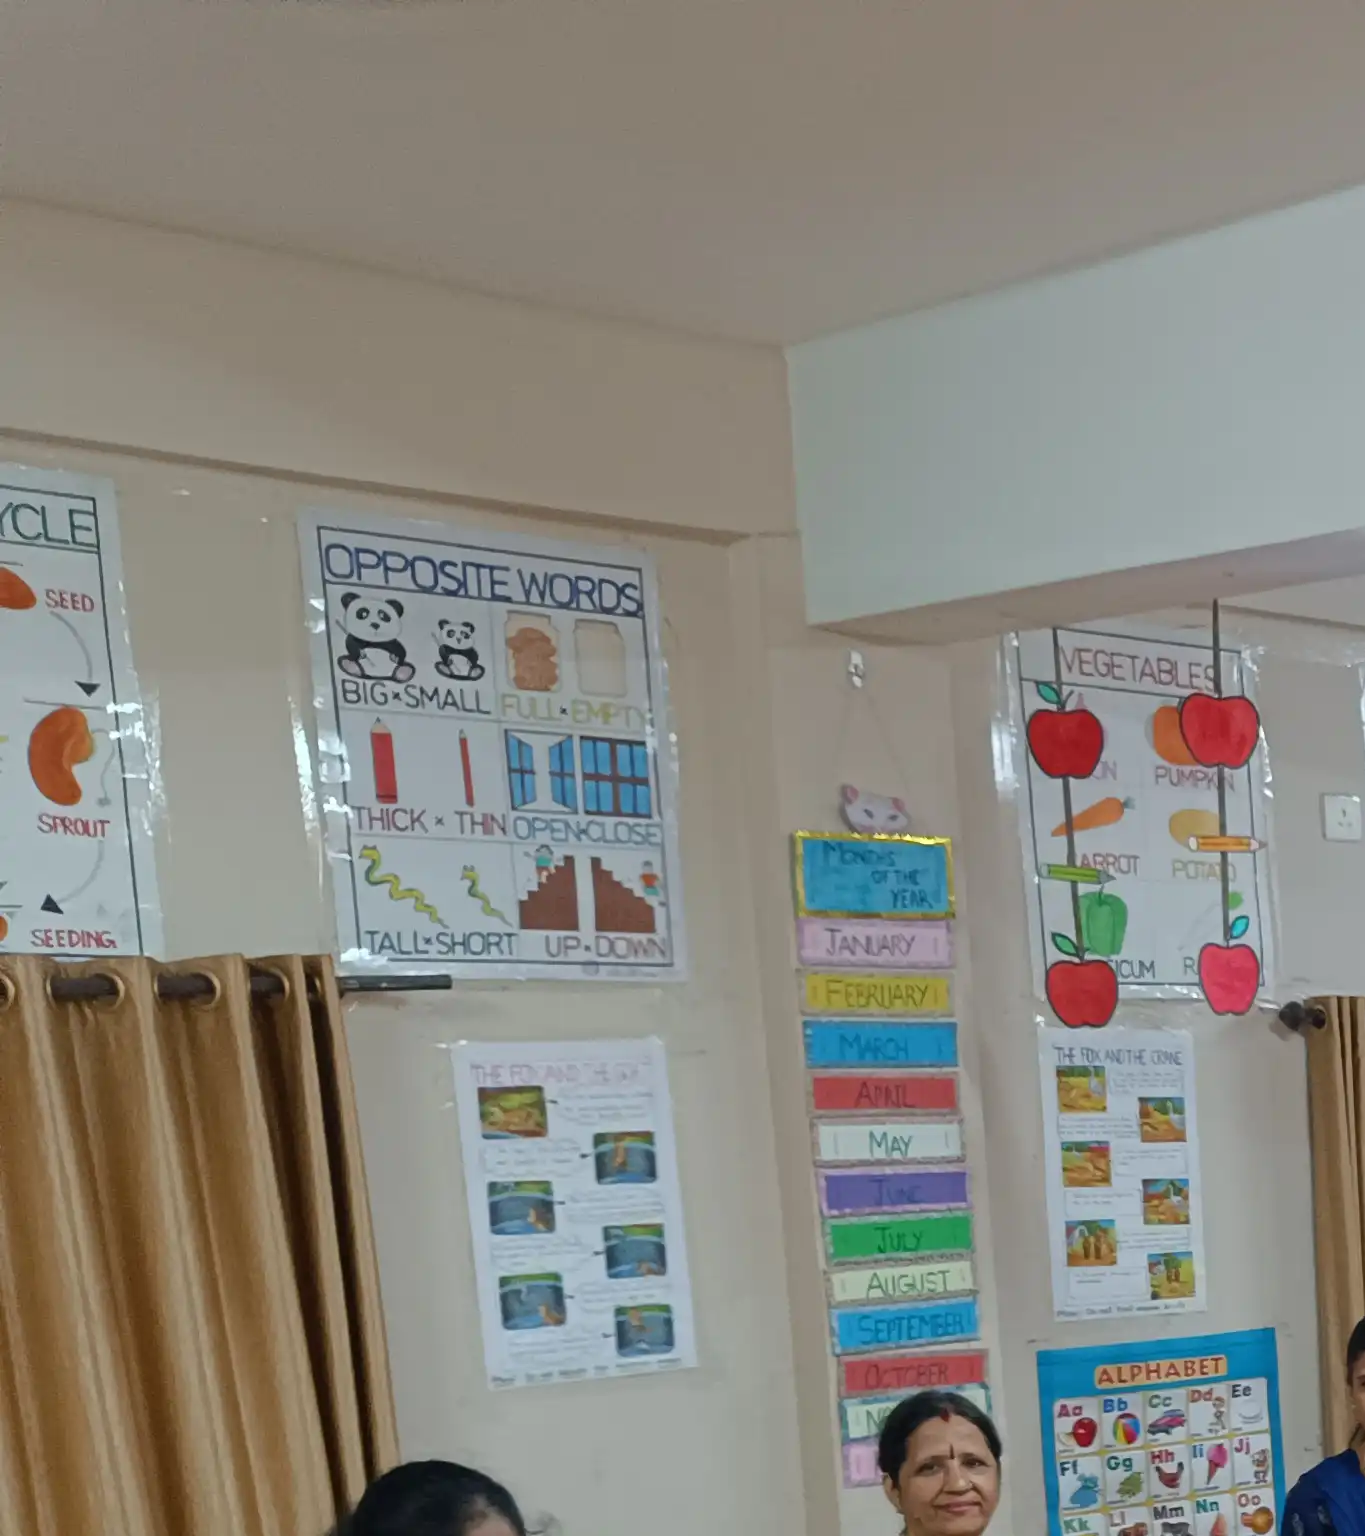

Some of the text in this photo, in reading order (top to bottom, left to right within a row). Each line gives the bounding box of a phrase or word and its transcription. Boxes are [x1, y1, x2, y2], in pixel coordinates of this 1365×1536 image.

[325, 543, 644, 616] OPPOSITE WORDS
[45, 588, 95, 613] SEED
[1060, 646, 1217, 692] VEGETABLES
[341, 678, 492, 715] BIG SMALL
[501, 694, 655, 727] FULL EMPTY
[1155, 765, 1235, 792] PUMPKN
[37, 813, 110, 838] SPROUT
[352, 806, 507, 836] THICK THIN
[512, 817, 661, 846] OPEN CLOSE
[821, 839, 896, 867] MONTHS
[1075, 853, 1140, 875] ARROT
[891, 868, 920, 886] THE
[889, 888, 933, 909] YEAR
[30, 928, 117, 950] SEEDING
[364, 930, 517, 957] TALL SHORT
[545, 934, 665, 960] UP DOWN
[824, 927, 917, 958] JANUARY
[825, 978, 930, 1010] FEBRUARY
[838, 1033, 909, 1061] MARCH
[1080, 1046, 1101, 1064] FOX
[854, 1080, 917, 1109] APRIL
[868, 1130, 914, 1157] MAY
[874, 1226, 924, 1253] JULY
[866, 1270, 952, 1299] AUGUST
[858, 1313, 965, 1345] SEPTEMBER
[864, 1362, 950, 1388] OCTOBER
[1098, 1356, 1225, 1386] ALPHABET
[1148, 1394, 1172, 1408] Cc
[1190, 1388, 1213, 1403] Dd
[1231, 1384, 1252, 1398] Ee
[1057, 1403, 1083, 1418] Aa
[1103, 1397, 1129, 1413] Bb
[1150, 1448, 1175, 1464] Hh
[1234, 1437, 1251, 1455] Jj
[1059, 1459, 1078, 1476] Ff
[1106, 1455, 1133, 1472] Gg
[1153, 1505, 1185, 1520] Mm
[1196, 1499, 1220, 1514] Nn
[1237, 1493, 1262, 1507] Oo
[1063, 1517, 1091, 1534] Kk
